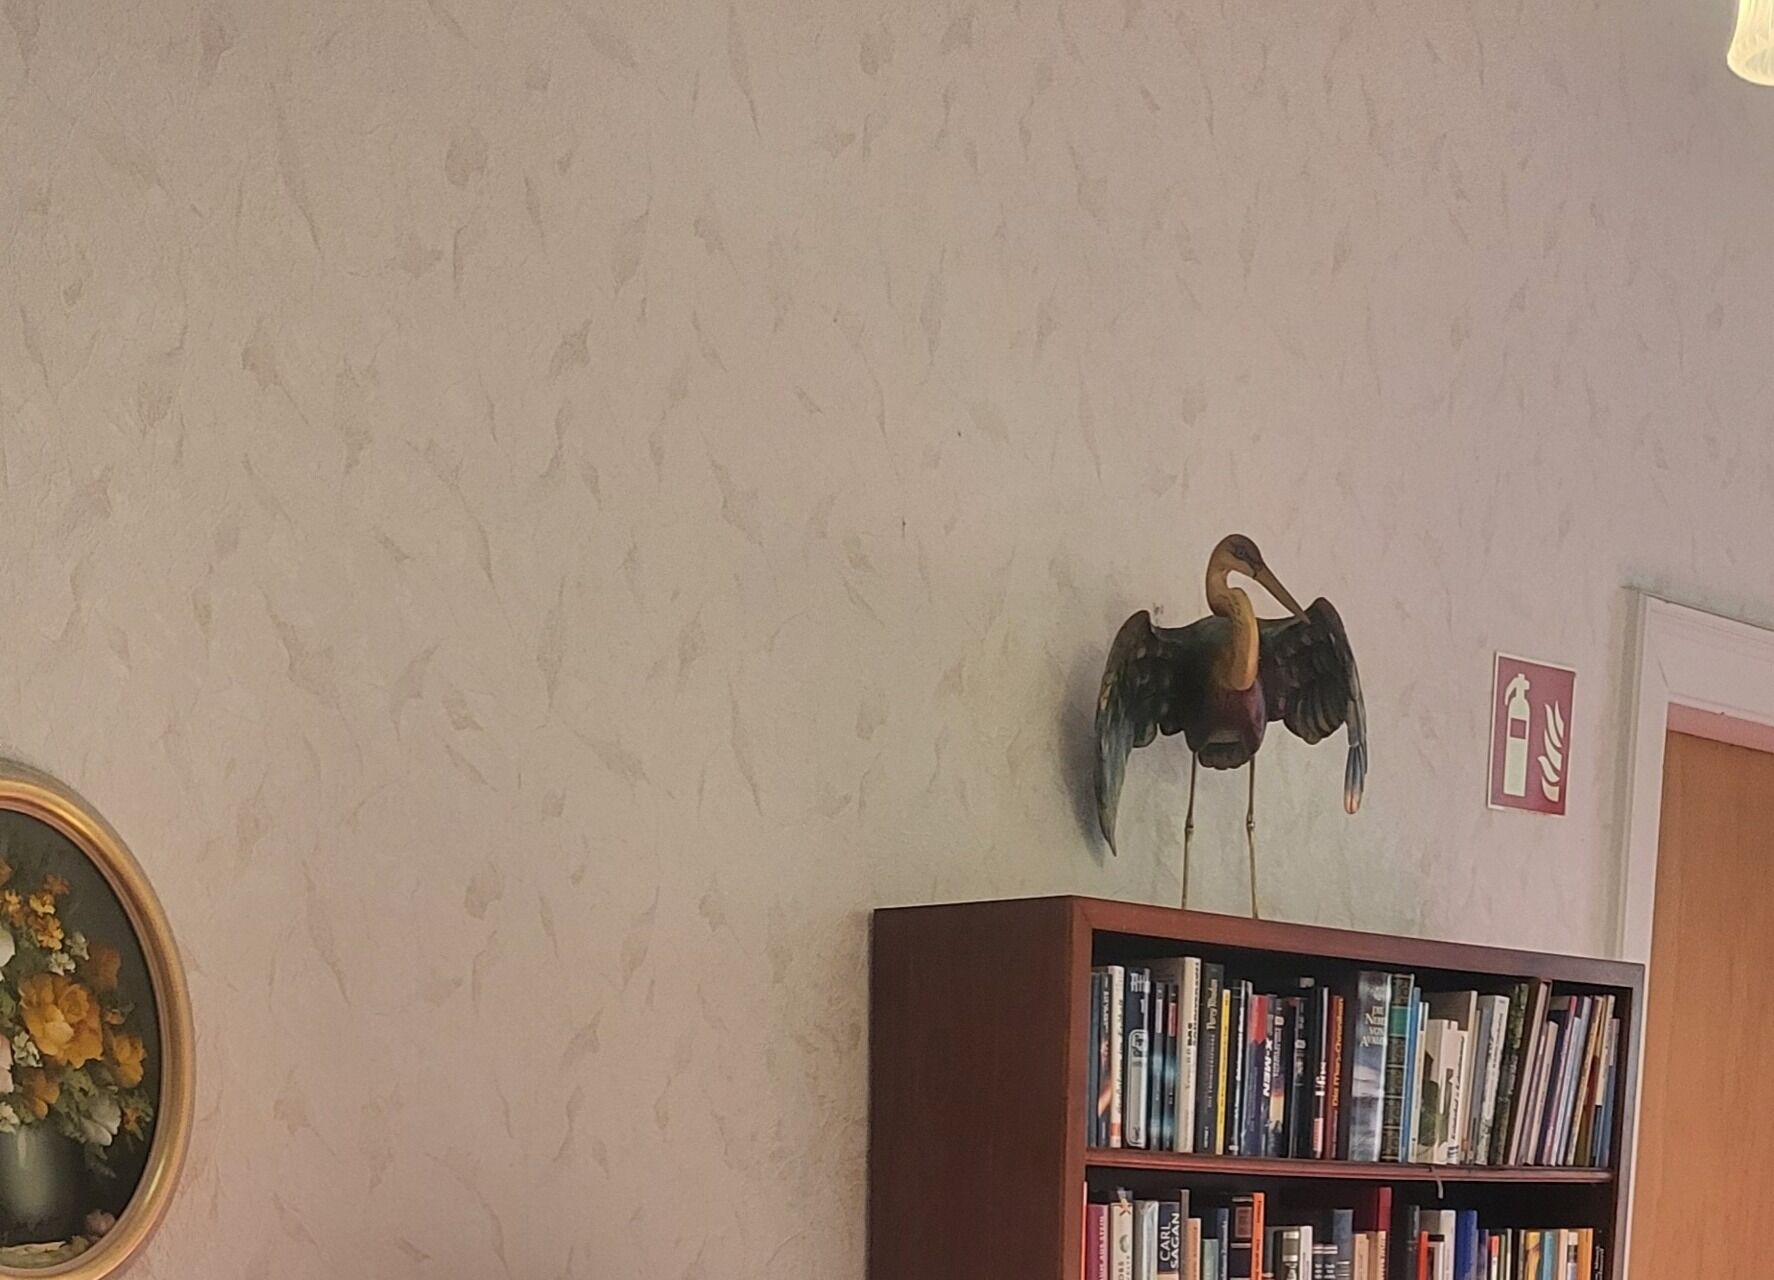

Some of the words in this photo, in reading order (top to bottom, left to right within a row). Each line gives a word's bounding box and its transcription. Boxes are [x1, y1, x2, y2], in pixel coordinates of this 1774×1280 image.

[1262, 1037, 1274, 1097] X-MEN
[1159, 1222, 1171, 1261] CARL
[1170, 1212, 1180, 1269] SAGAN
